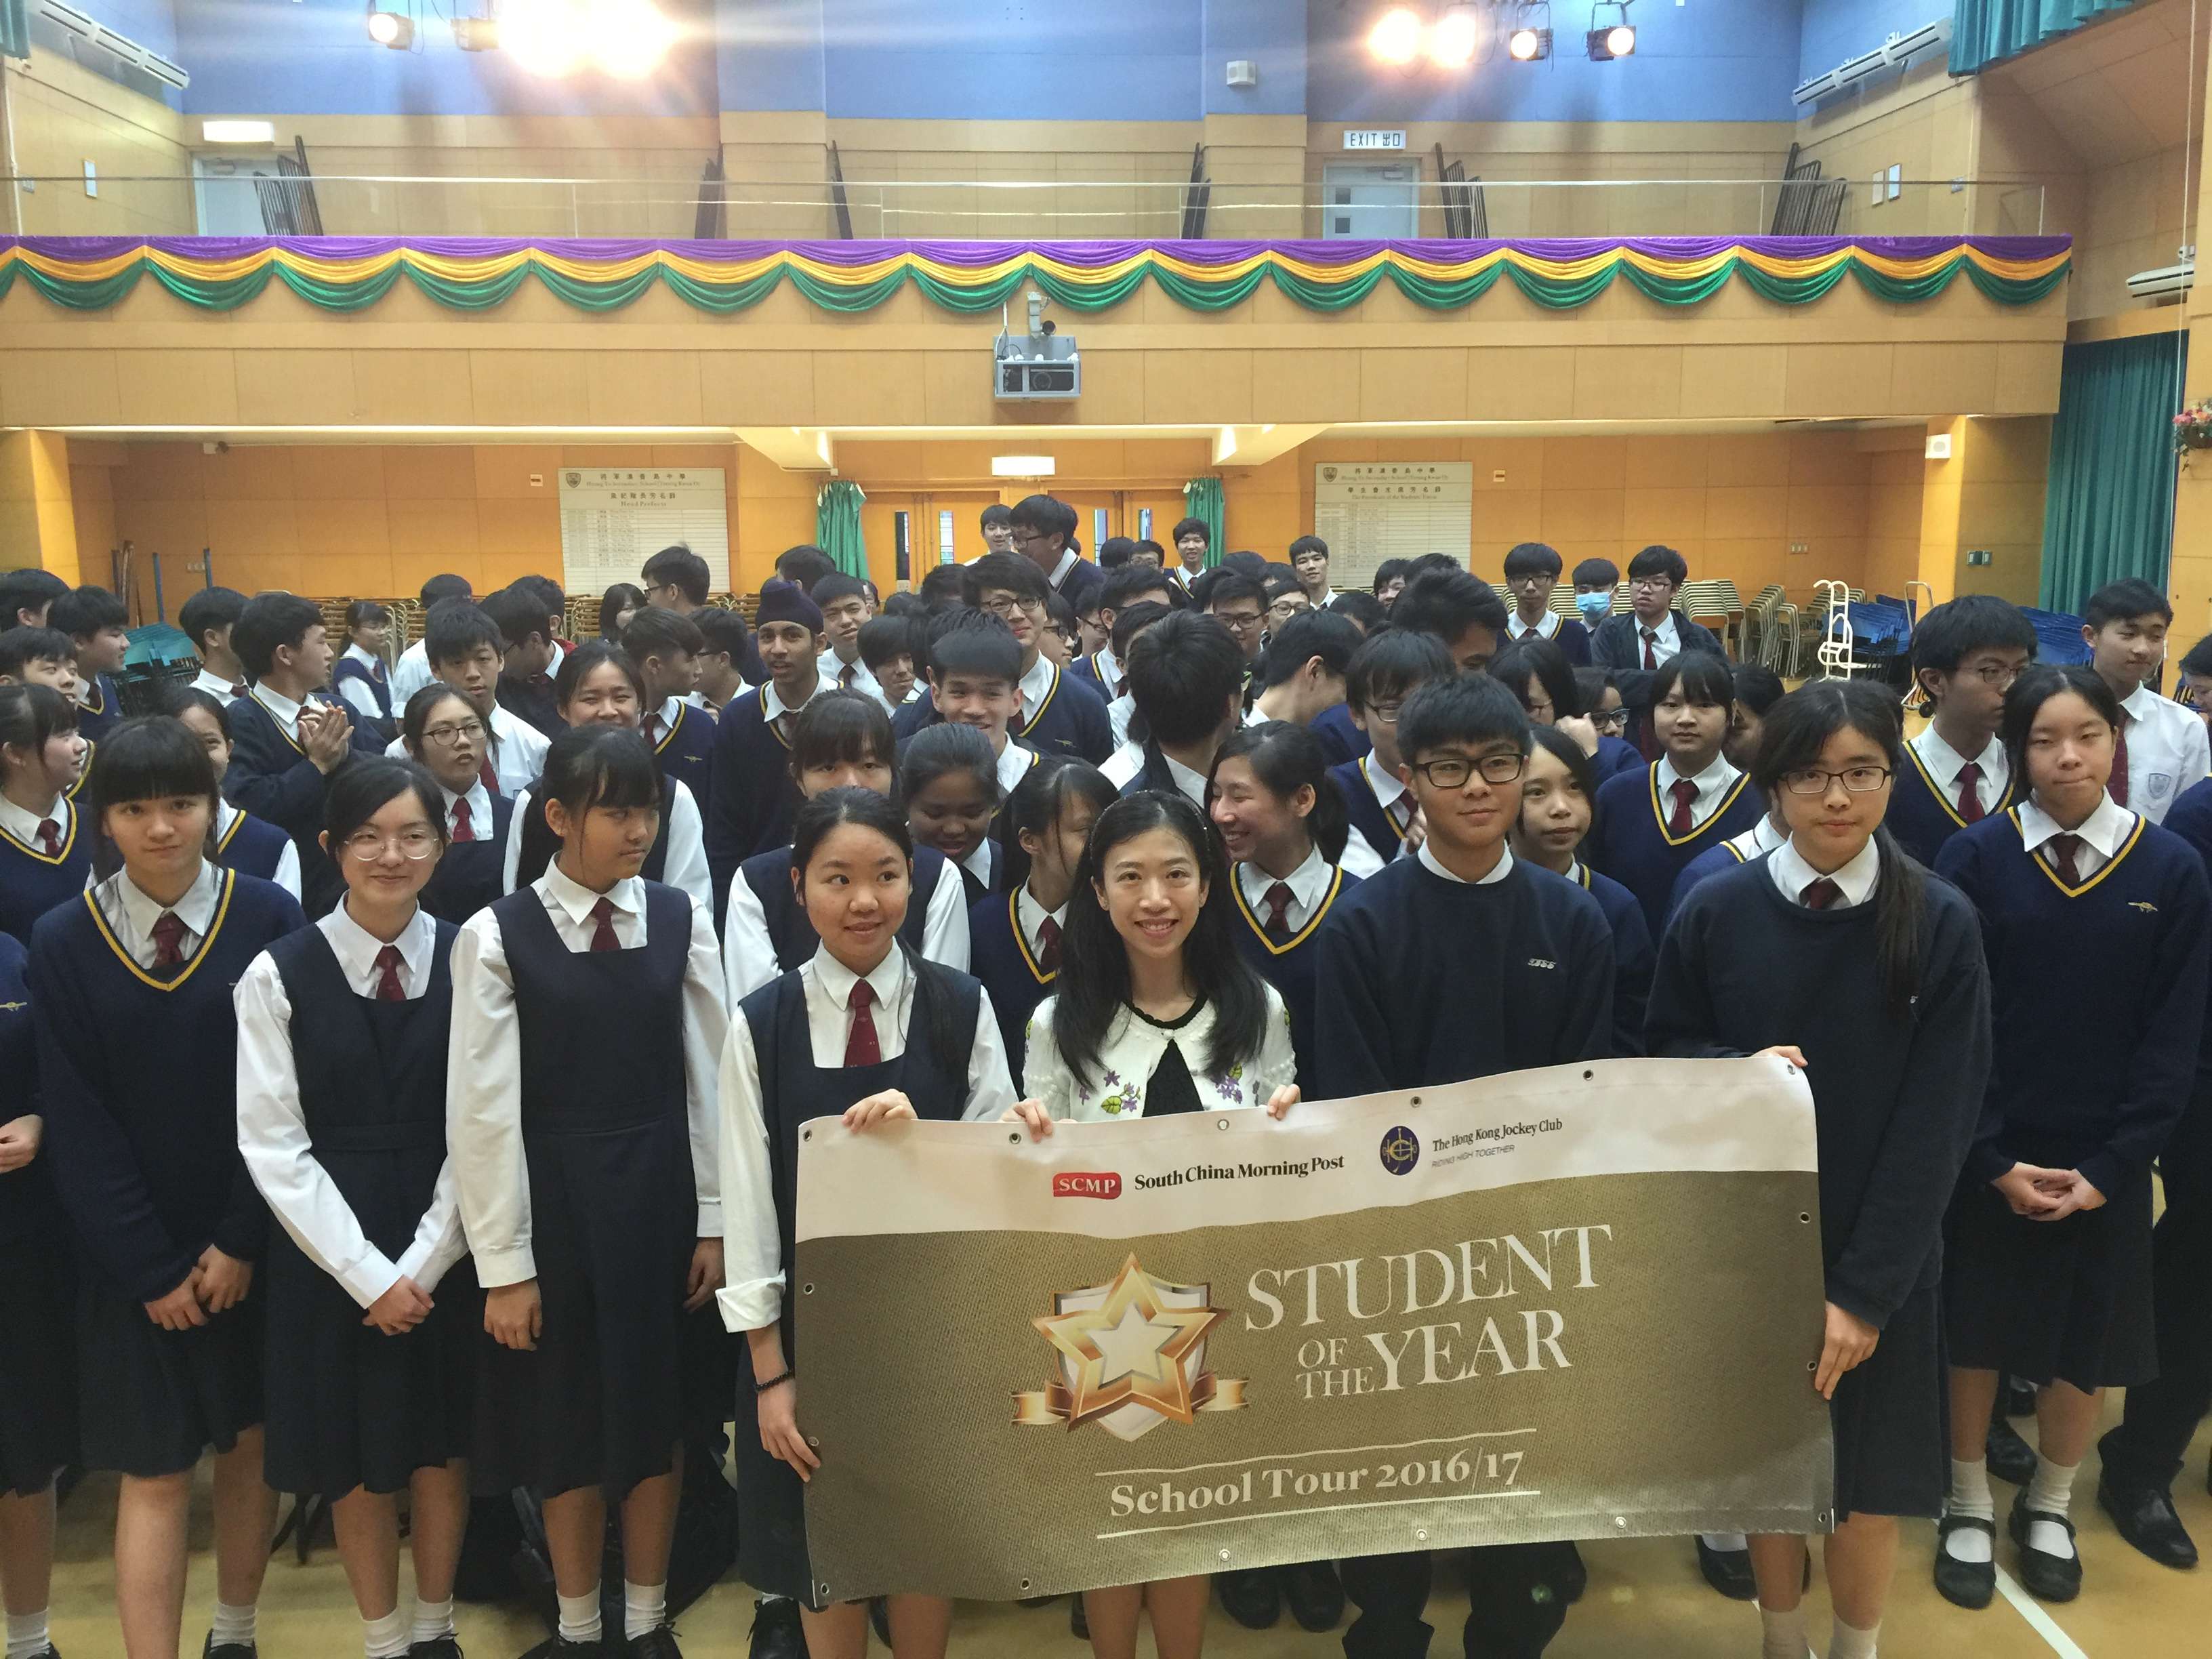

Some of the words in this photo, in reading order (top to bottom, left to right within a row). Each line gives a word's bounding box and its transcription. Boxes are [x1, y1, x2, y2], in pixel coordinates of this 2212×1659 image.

[1350, 133, 1377, 146] EXIT
[1382, 133, 1401, 146] 出口
[1433, 1139, 1450, 1151] The
[1452, 1132, 1473, 1147] Hong
[1475, 1128, 1500, 1141] Kong
[1501, 1122, 1537, 1139] Jockey
[1539, 1118, 1563, 1132] Club
[1134, 1170, 1183, 1190] South
[1185, 1164, 1235, 1183] China
[1237, 1161, 1309, 1178] Morning
[1311, 1155, 1345, 1172] Post
[1432, 1155, 1456, 1168] RIDING
[1457, 1151, 1473, 1161] HIGH
[1475, 1144, 1515, 1158] TOGETHER
[1059, 1178, 1116, 1193] SCMP
[1246, 1224, 1612, 1331] STUDENT
[1296, 1366, 1375, 1399] THE
[1361, 1309, 1573, 1391] YEAR
[1297, 1338, 1348, 1368] OF
[1110, 1469, 1252, 1517] School
[1261, 1468, 1369, 1499] Tour
[1376, 1446, 1524, 1491] 2016/17
